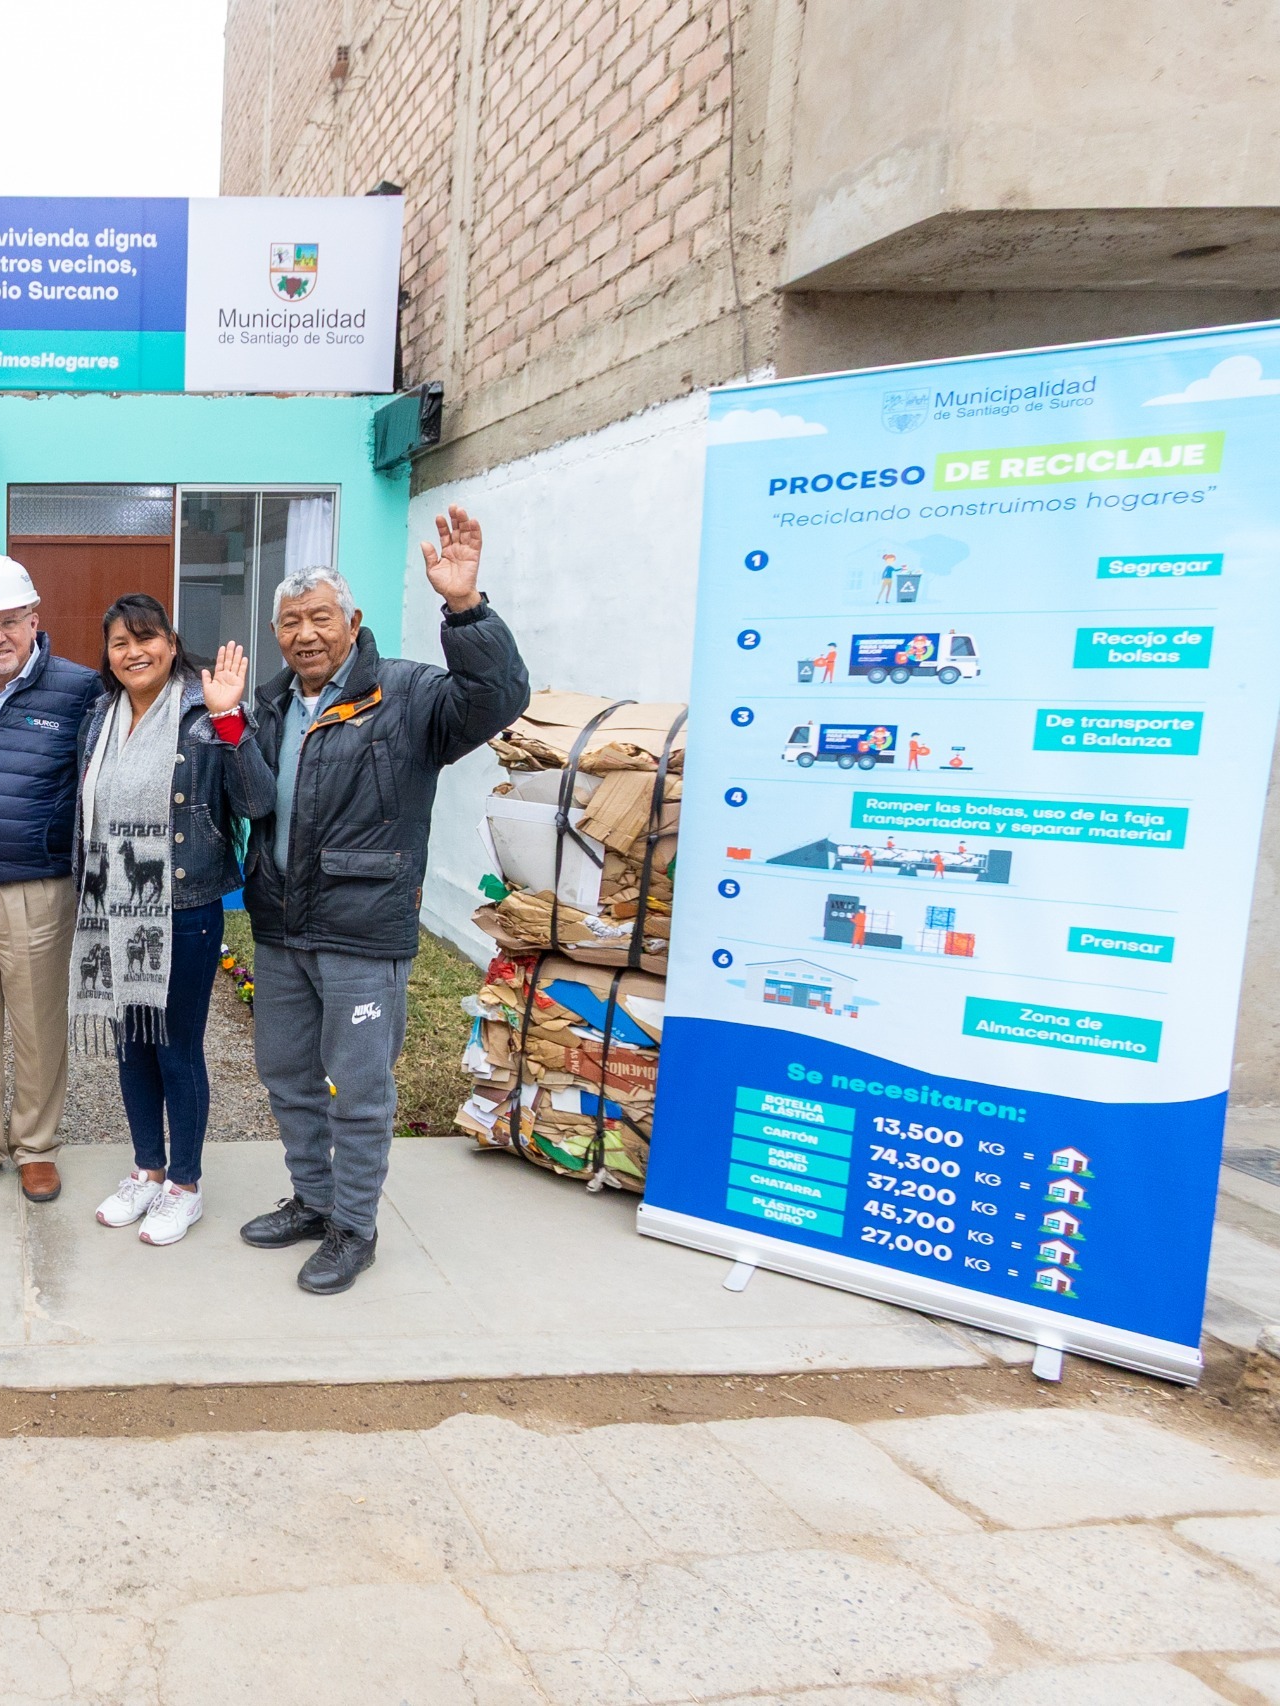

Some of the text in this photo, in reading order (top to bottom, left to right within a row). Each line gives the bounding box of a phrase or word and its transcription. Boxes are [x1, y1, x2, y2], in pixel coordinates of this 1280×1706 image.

[95, 228, 157, 252] digna
[48, 254, 137, 277] vecinos,
[28, 281, 119, 300] Surcano
[219, 308, 366, 333] Municipalidad
[218, 331, 365, 347] de Santiago de Surco
[934, 376, 1097, 408] Municipalidad
[933, 397, 1094, 421] de Santiago de Surco
[768, 443, 1207, 496] PROCESO DE RECICLAJE
[919, 497, 1076, 519] construimos
[751, 554, 762, 567] 1
[1108, 560, 1213, 577] Segregar
[744, 634, 756, 645] 2
[1092, 631, 1203, 648] Recojo de
[1108, 649, 1181, 662] bolsas
[33, 718, 60, 729] SURCO
[737, 711, 749, 723] 3
[1046, 714, 1195, 732] De transporte
[1061, 733, 1172, 747] a Balanza
[731, 791, 743, 802] 4
[866, 798, 1164, 827] Romper las bolsas, uso de la faja
[862, 813, 1172, 842] transportadora y separar material
[724, 883, 736, 894] 5
[1080, 933, 1164, 955] Prensar
[718, 953, 729, 964] 6
[1019, 1008, 1103, 1031] Zona de
[975, 1019, 1147, 1054] Almacenamiento
[787, 1062, 1027, 1123] Se necesitaron:
[761, 1102, 825, 1124] PLÁSTICA
[765, 1094, 823, 1114] BOTELLA
[762, 1126, 819, 1145] CARTÓN
[872, 1116, 964, 1148] 13,500
[978, 1140, 1006, 1156] KG
[768, 1147, 809, 1164] PAPEL
[768, 1157, 808, 1173] BOND
[869, 1144, 961, 1178] 74,300
[974, 1171, 1002, 1187] KG
[750, 1174, 822, 1199] CHATARRA
[866, 1172, 957, 1206] 37,200
[971, 1200, 998, 1216] KG
[752, 1196, 818, 1220] PLÁSTICO
[764, 1208, 803, 1226] DURO
[863, 1200, 955, 1234] 45,700
[967, 1229, 995, 1245] KG
[860, 1226, 953, 1262] 27,000
[964, 1256, 991, 1272] KG
